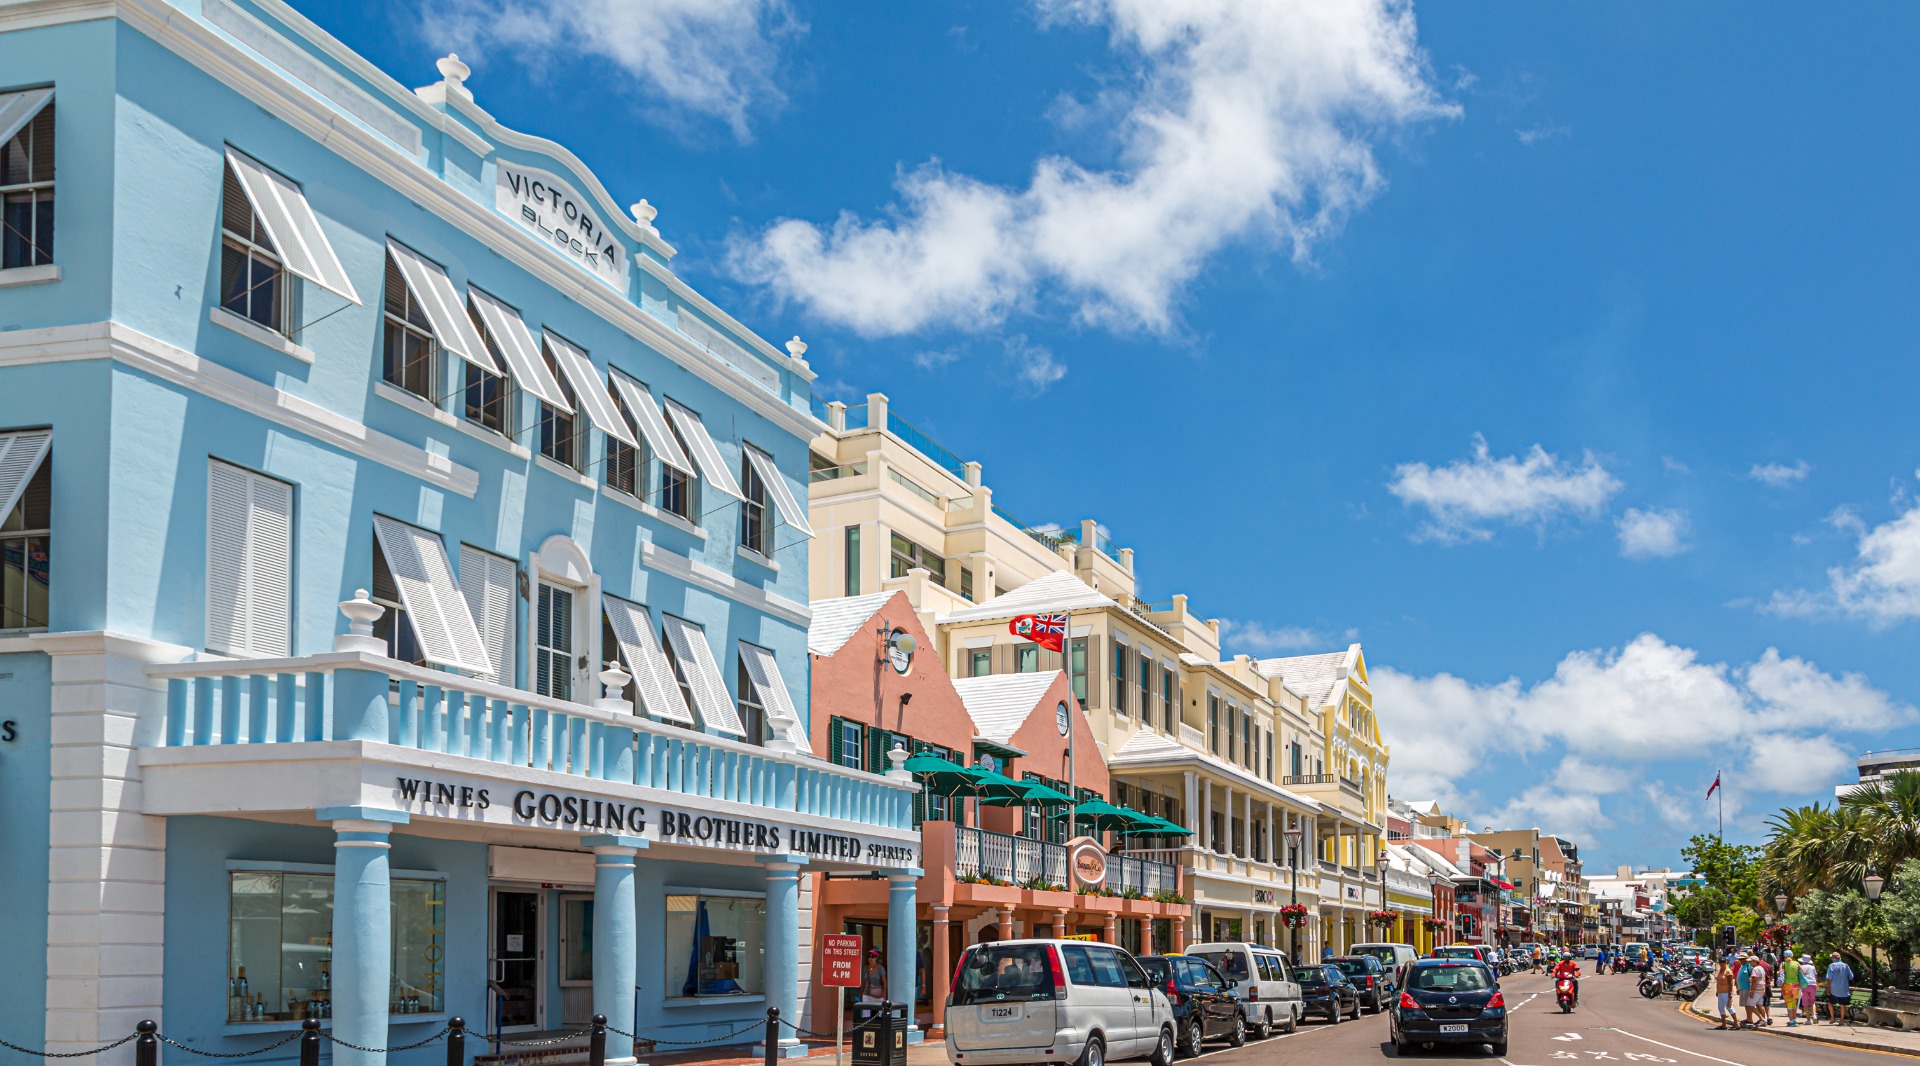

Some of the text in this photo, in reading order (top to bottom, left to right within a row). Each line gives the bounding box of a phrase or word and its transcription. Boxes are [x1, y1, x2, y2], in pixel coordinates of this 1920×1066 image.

[506, 171, 615, 265] VICTORIA
[522, 204, 598, 265] BLOCK
[397, 777, 912, 861] WINES GOSLING BROTHERS LIMITED SPIRITS
